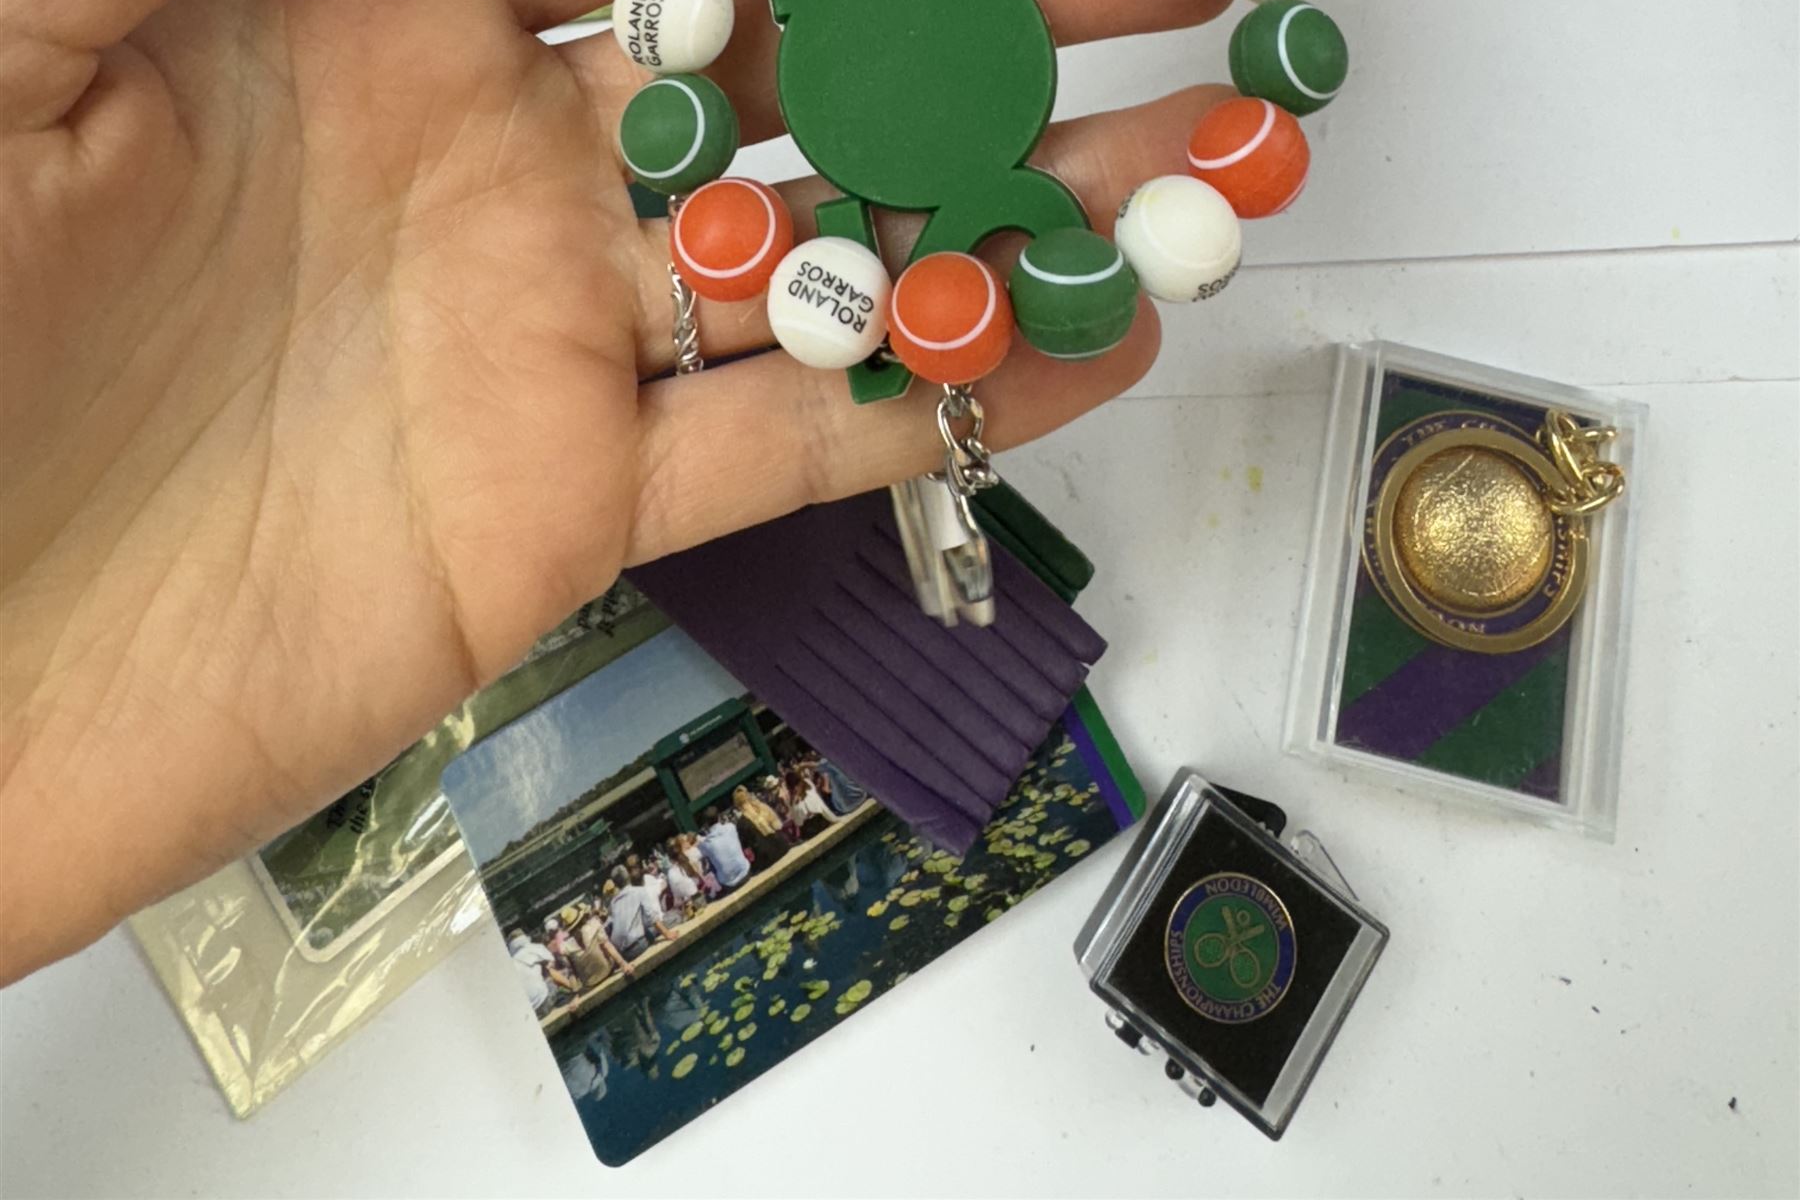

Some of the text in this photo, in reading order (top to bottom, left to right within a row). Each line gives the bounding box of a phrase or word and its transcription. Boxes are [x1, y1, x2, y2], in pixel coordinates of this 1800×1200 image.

[787, 279, 868, 335] ROLAND
[796, 260, 875, 314] GARROS
[1204, 878, 1288, 931] WIMBLEDON
[1169, 929, 1283, 1019] THE CHAMPIONSHIPS
